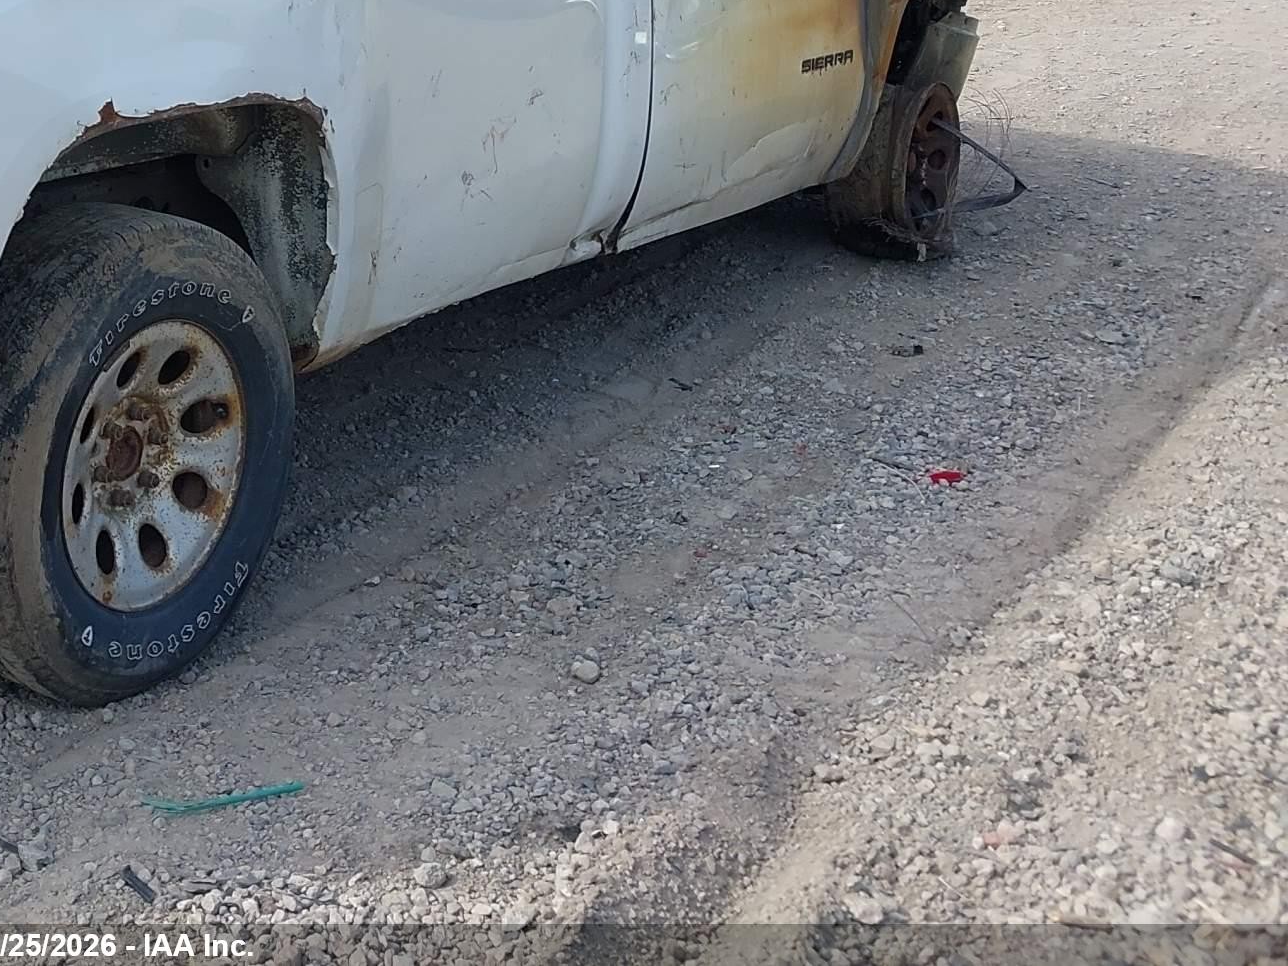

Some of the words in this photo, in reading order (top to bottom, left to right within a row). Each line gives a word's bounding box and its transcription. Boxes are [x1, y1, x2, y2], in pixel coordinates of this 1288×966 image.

[801, 49, 854, 75] SIERRA
[88, 280, 232, 367] Firestone
[107, 560, 249, 661] Firestone
